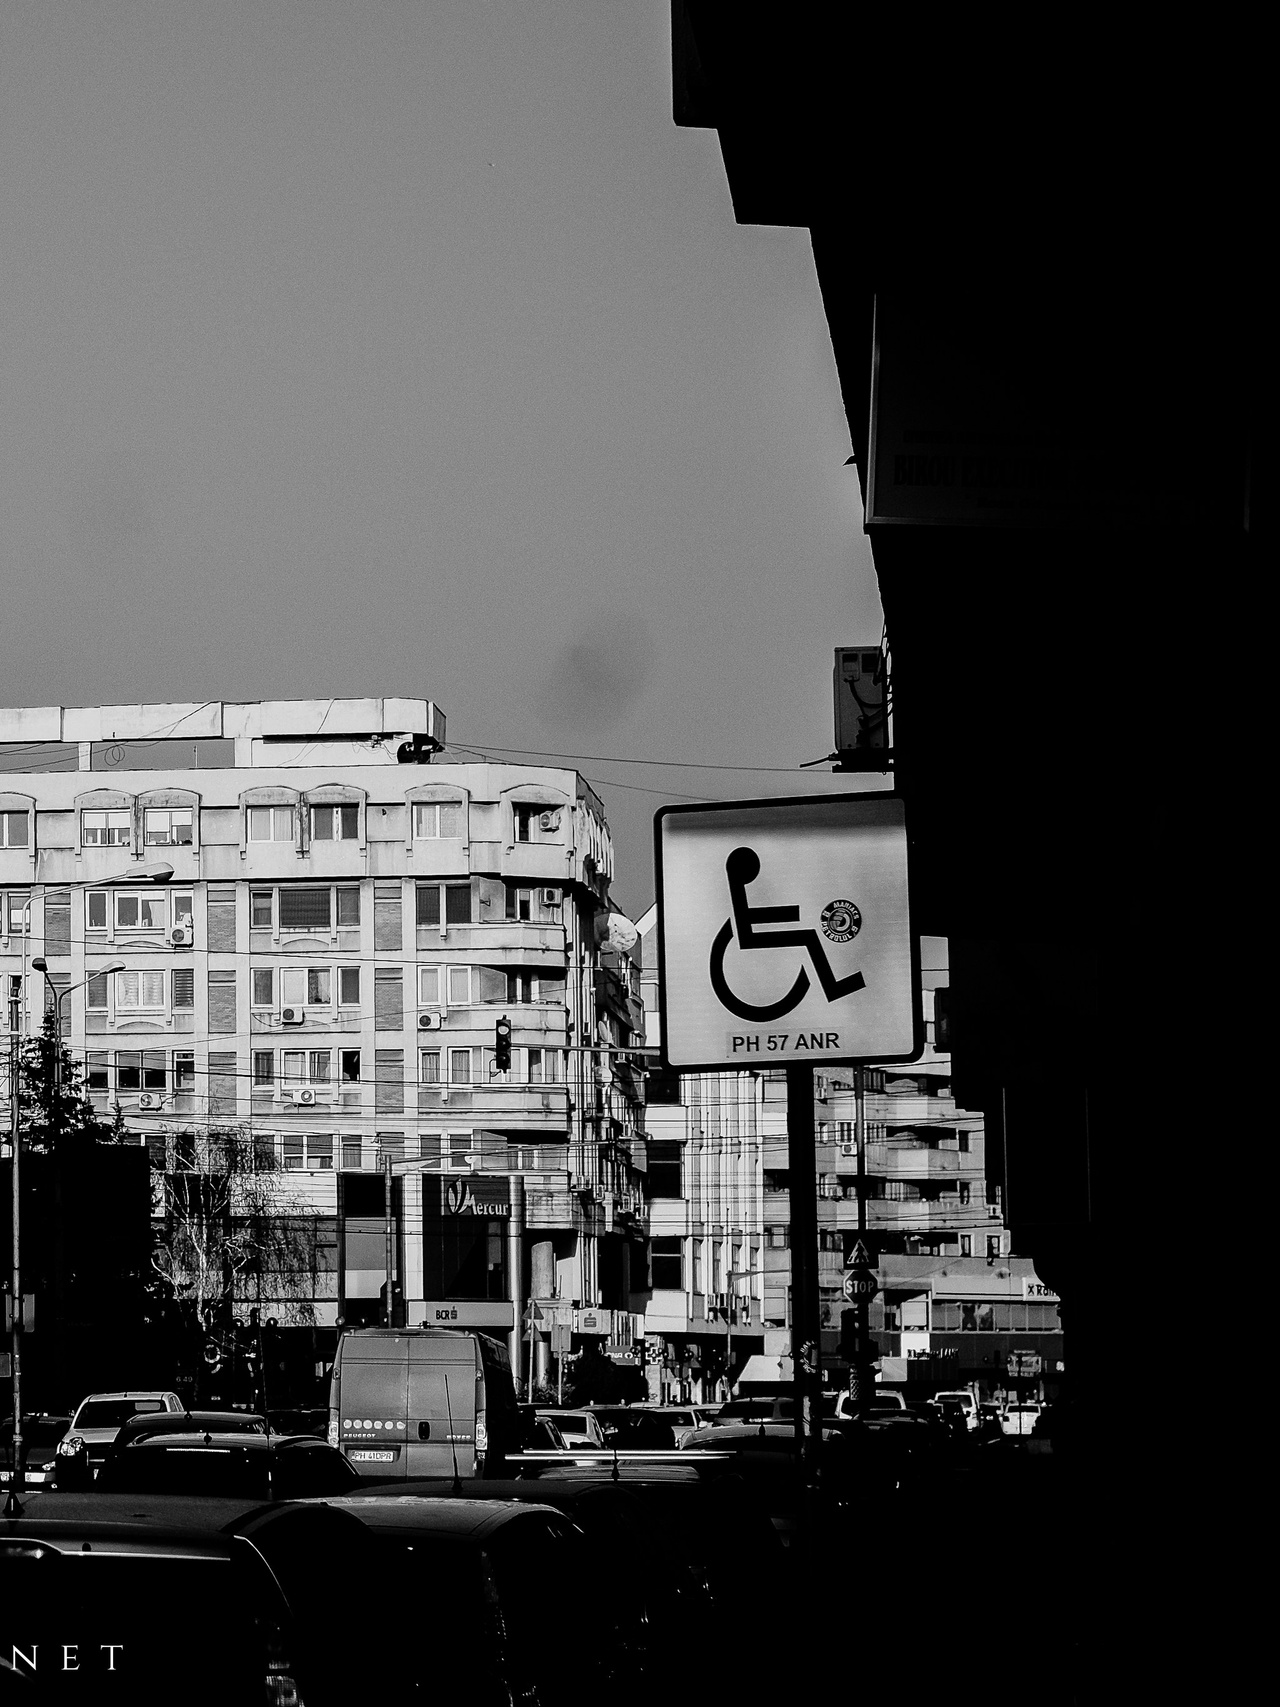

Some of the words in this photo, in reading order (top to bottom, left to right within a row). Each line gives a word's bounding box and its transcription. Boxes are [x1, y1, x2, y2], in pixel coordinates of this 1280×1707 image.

[733, 1036, 759, 1052] PH
[767, 1034, 789, 1051] 57
[794, 1032, 840, 1050] ANR
[846, 1280, 874, 1293] STOP
[435, 1309, 450, 1320] BCR
